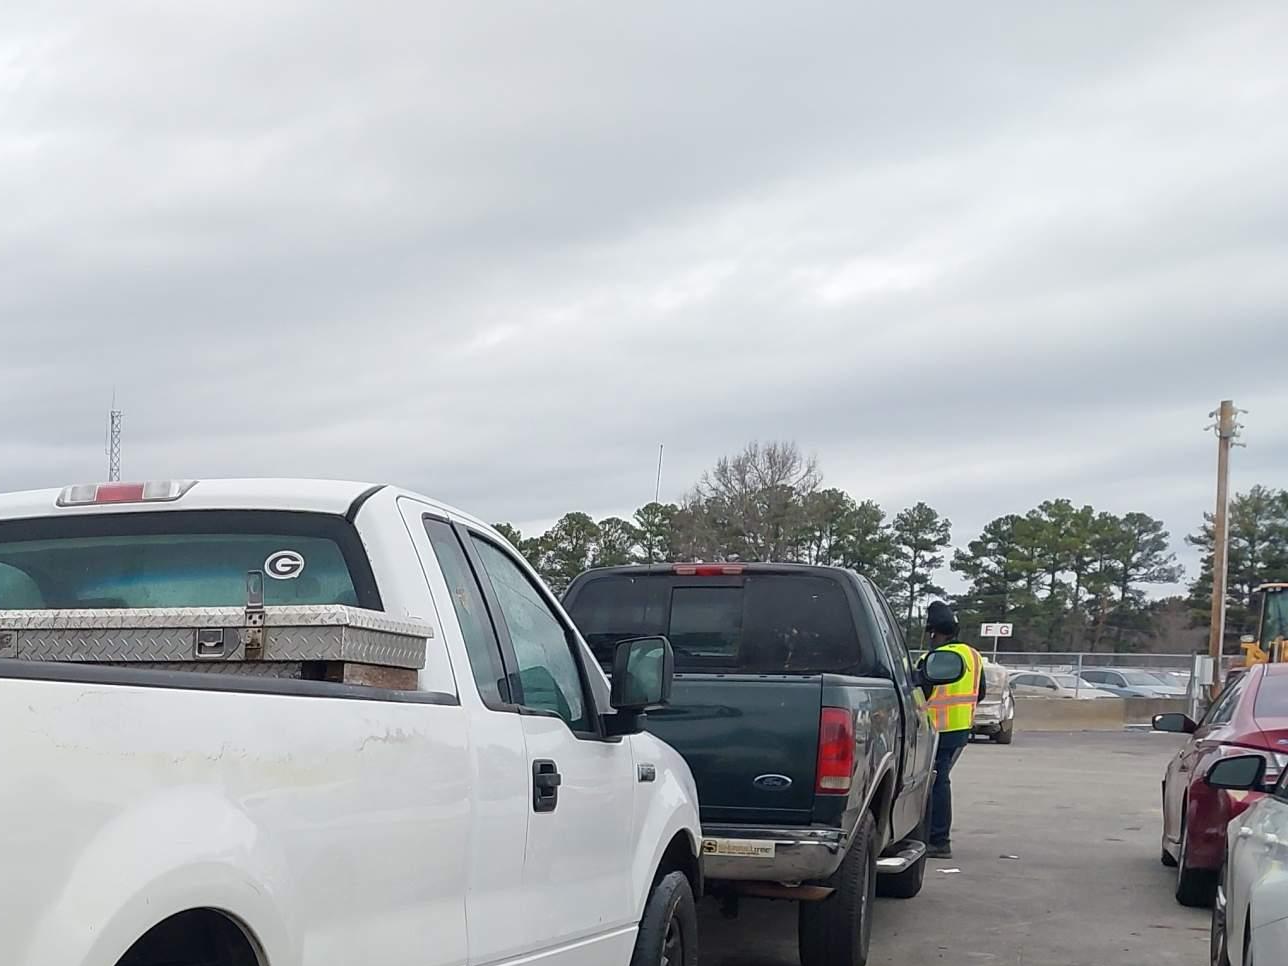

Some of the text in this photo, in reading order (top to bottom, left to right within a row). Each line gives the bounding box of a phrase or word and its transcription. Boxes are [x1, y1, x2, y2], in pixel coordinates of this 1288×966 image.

[268, 555, 300, 576] G
[984, 625, 1010, 635] F G
